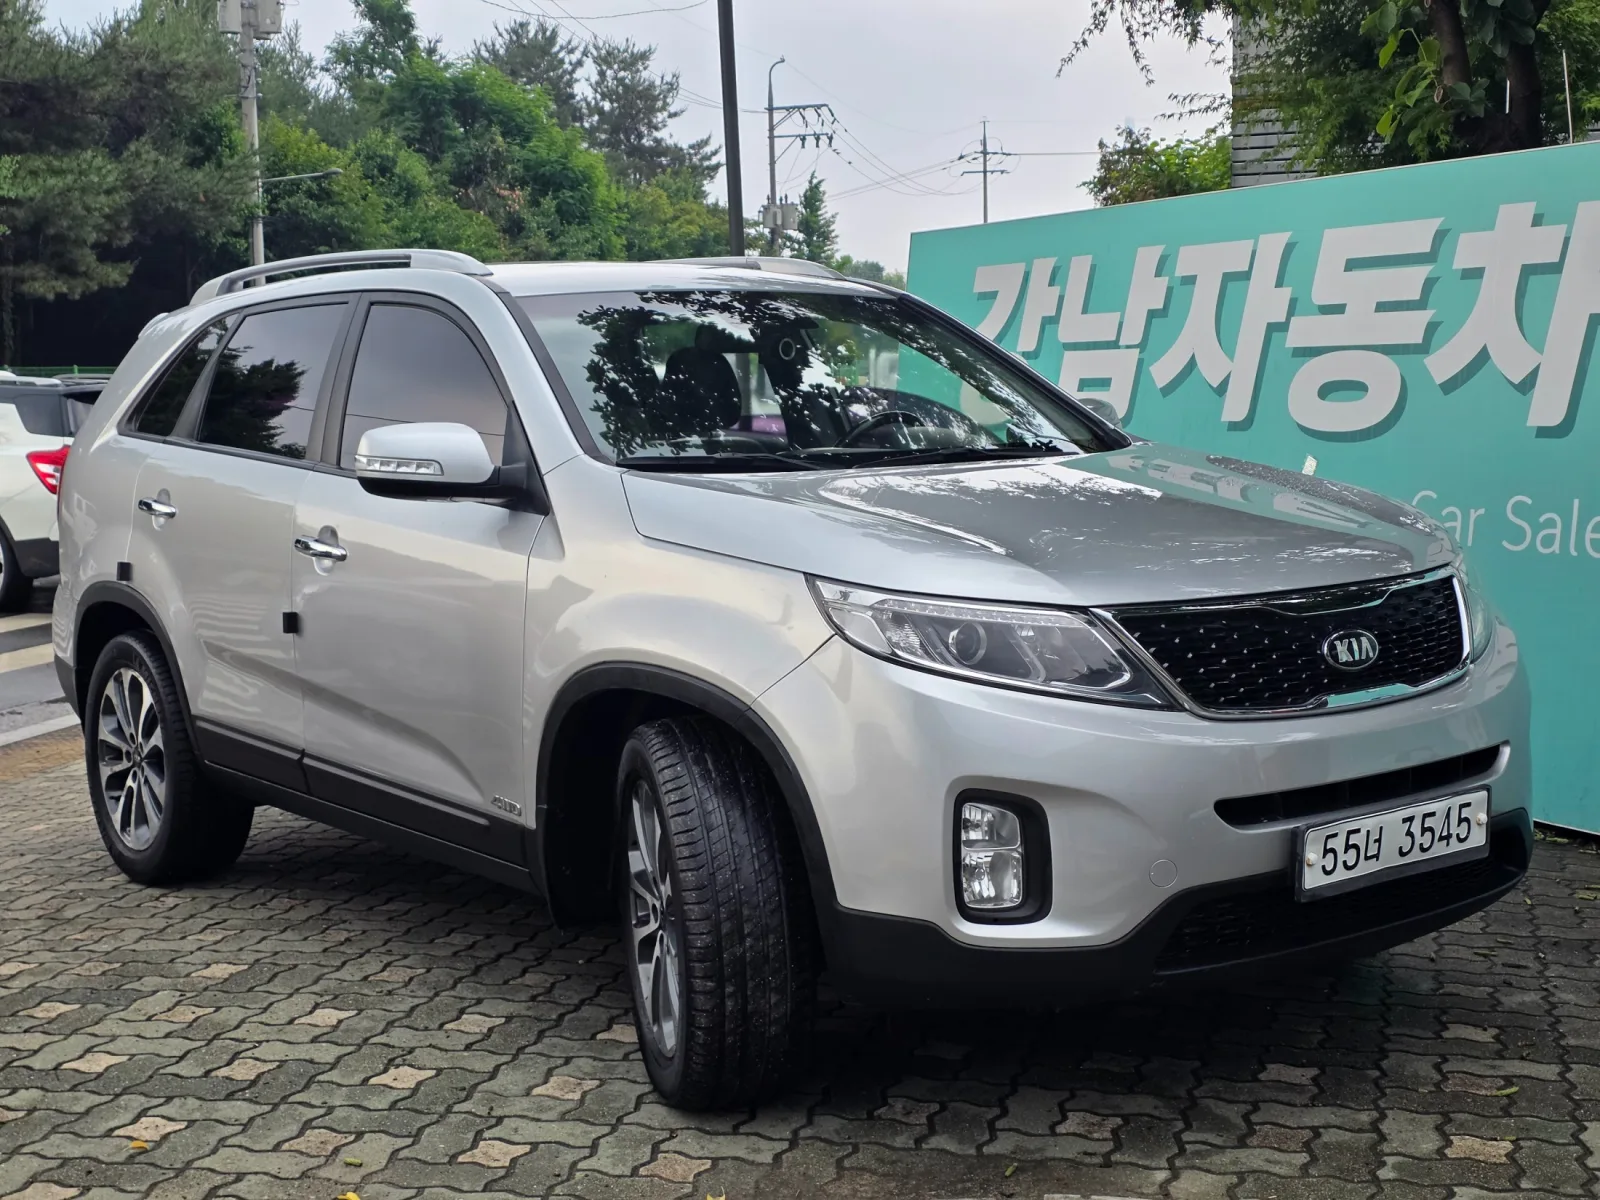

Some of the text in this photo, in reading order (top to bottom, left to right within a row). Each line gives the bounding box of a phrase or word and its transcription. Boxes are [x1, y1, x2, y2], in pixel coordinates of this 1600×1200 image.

[1333, 636, 1374, 663] KIA
[1321, 801, 1473, 876] 55너 3545
